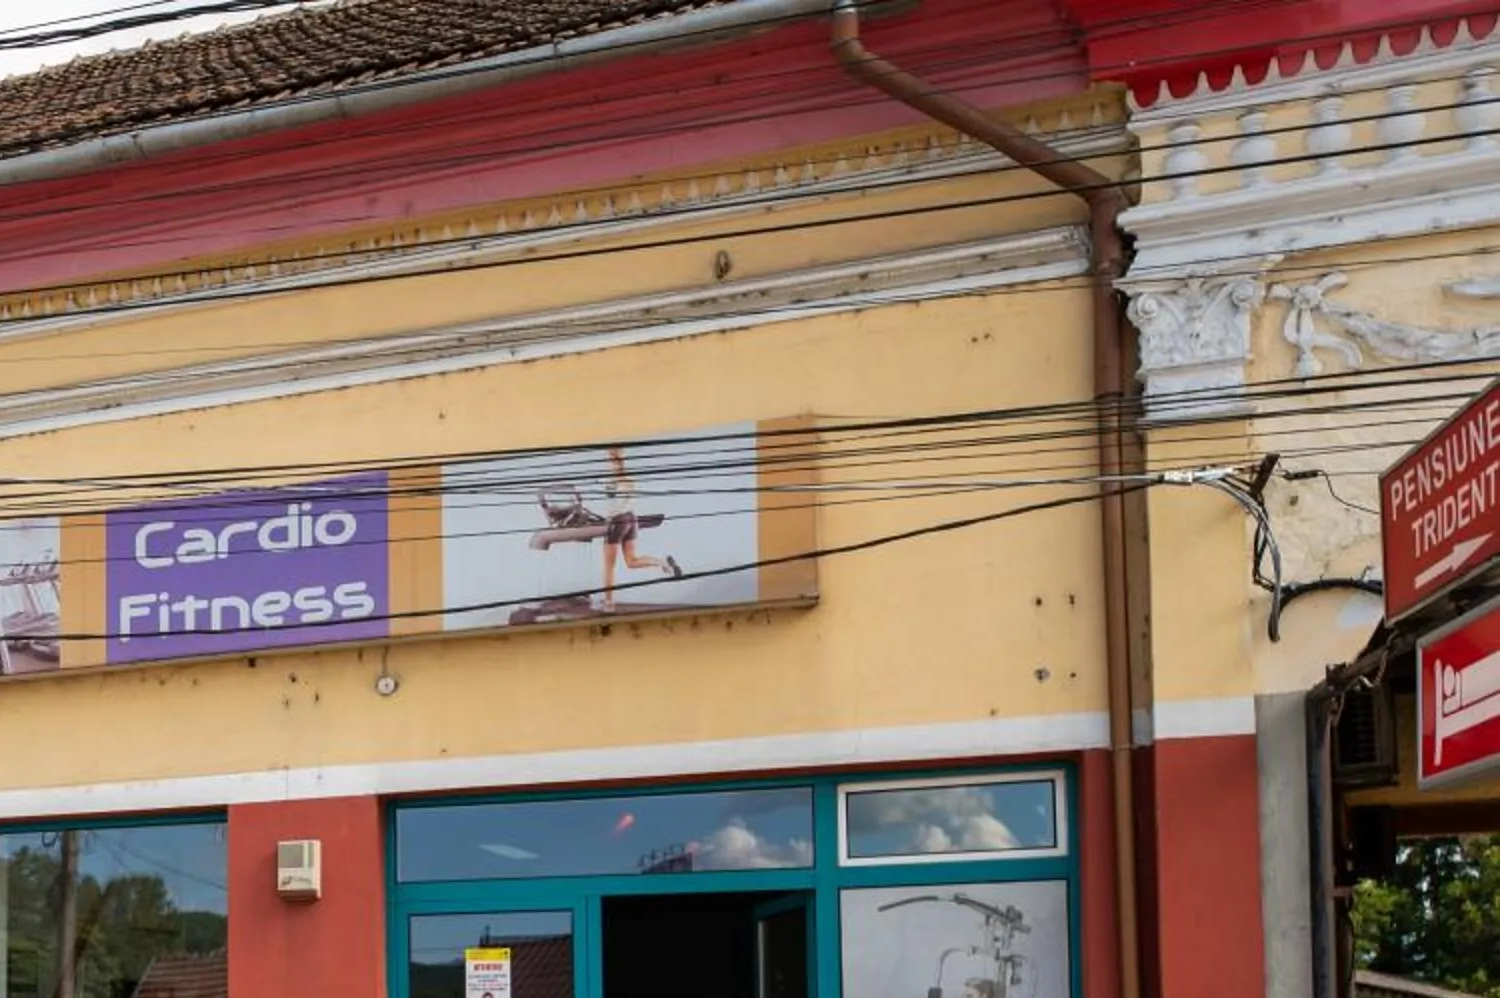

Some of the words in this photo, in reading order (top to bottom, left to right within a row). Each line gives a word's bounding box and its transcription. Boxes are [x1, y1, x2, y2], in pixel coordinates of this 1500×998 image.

[1391, 400, 1500, 521] PENSIUNE
[135, 501, 357, 569] Cardio
[1411, 460, 1500, 558] TRIDENT
[119, 581, 375, 642] Fitness
